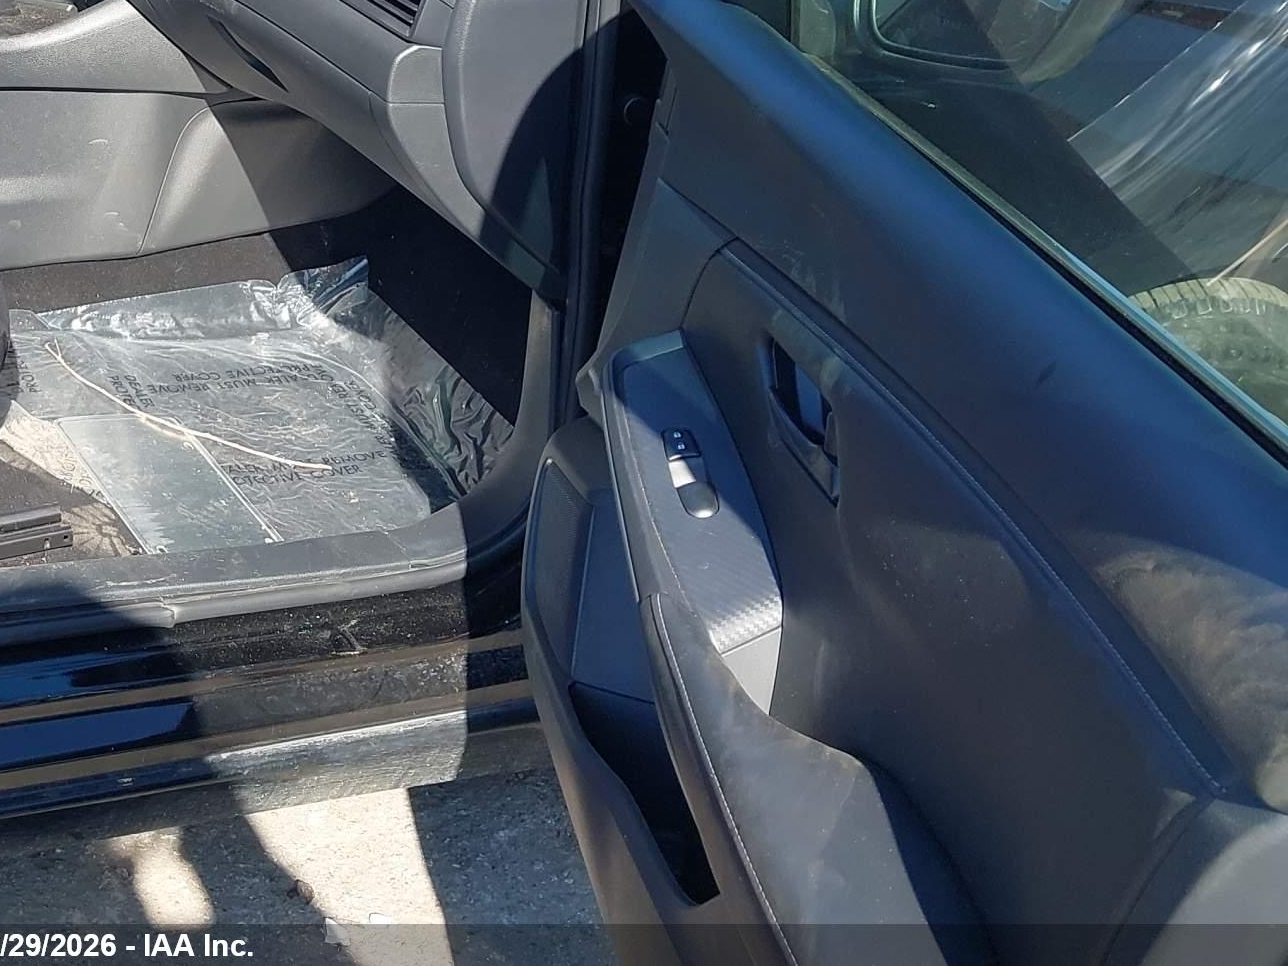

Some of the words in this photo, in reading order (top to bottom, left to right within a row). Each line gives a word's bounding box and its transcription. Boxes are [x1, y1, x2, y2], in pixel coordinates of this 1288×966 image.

[172, 371, 221, 382] COVER
[147, 379, 211, 394] REMOVE
[217, 378, 258, 390] MUST
[322, 451, 387, 465] REMOVE
